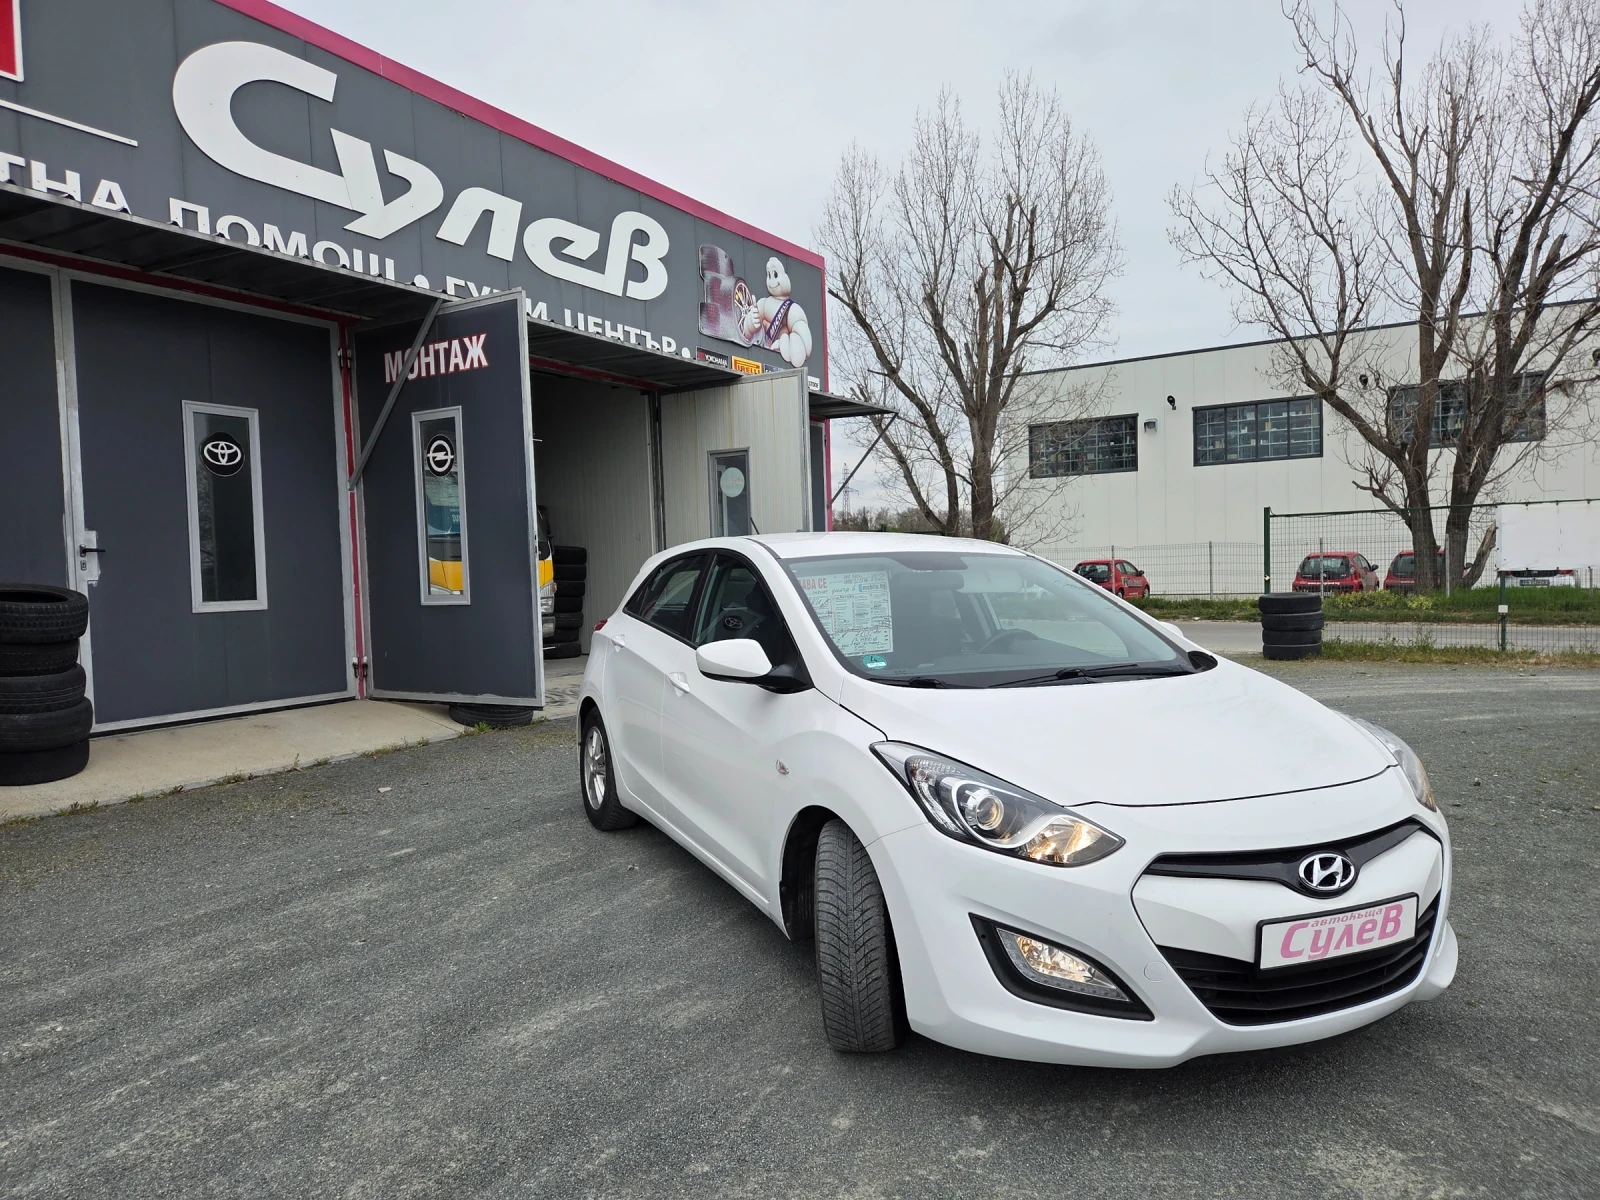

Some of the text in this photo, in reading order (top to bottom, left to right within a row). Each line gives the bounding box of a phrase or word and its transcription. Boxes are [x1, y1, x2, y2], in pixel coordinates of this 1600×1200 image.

[384, 333, 489, 383] МОНТАЖ
[704, 353, 728, 367] YOKOHAMA
[1311, 907, 1383, 928] автокъща
